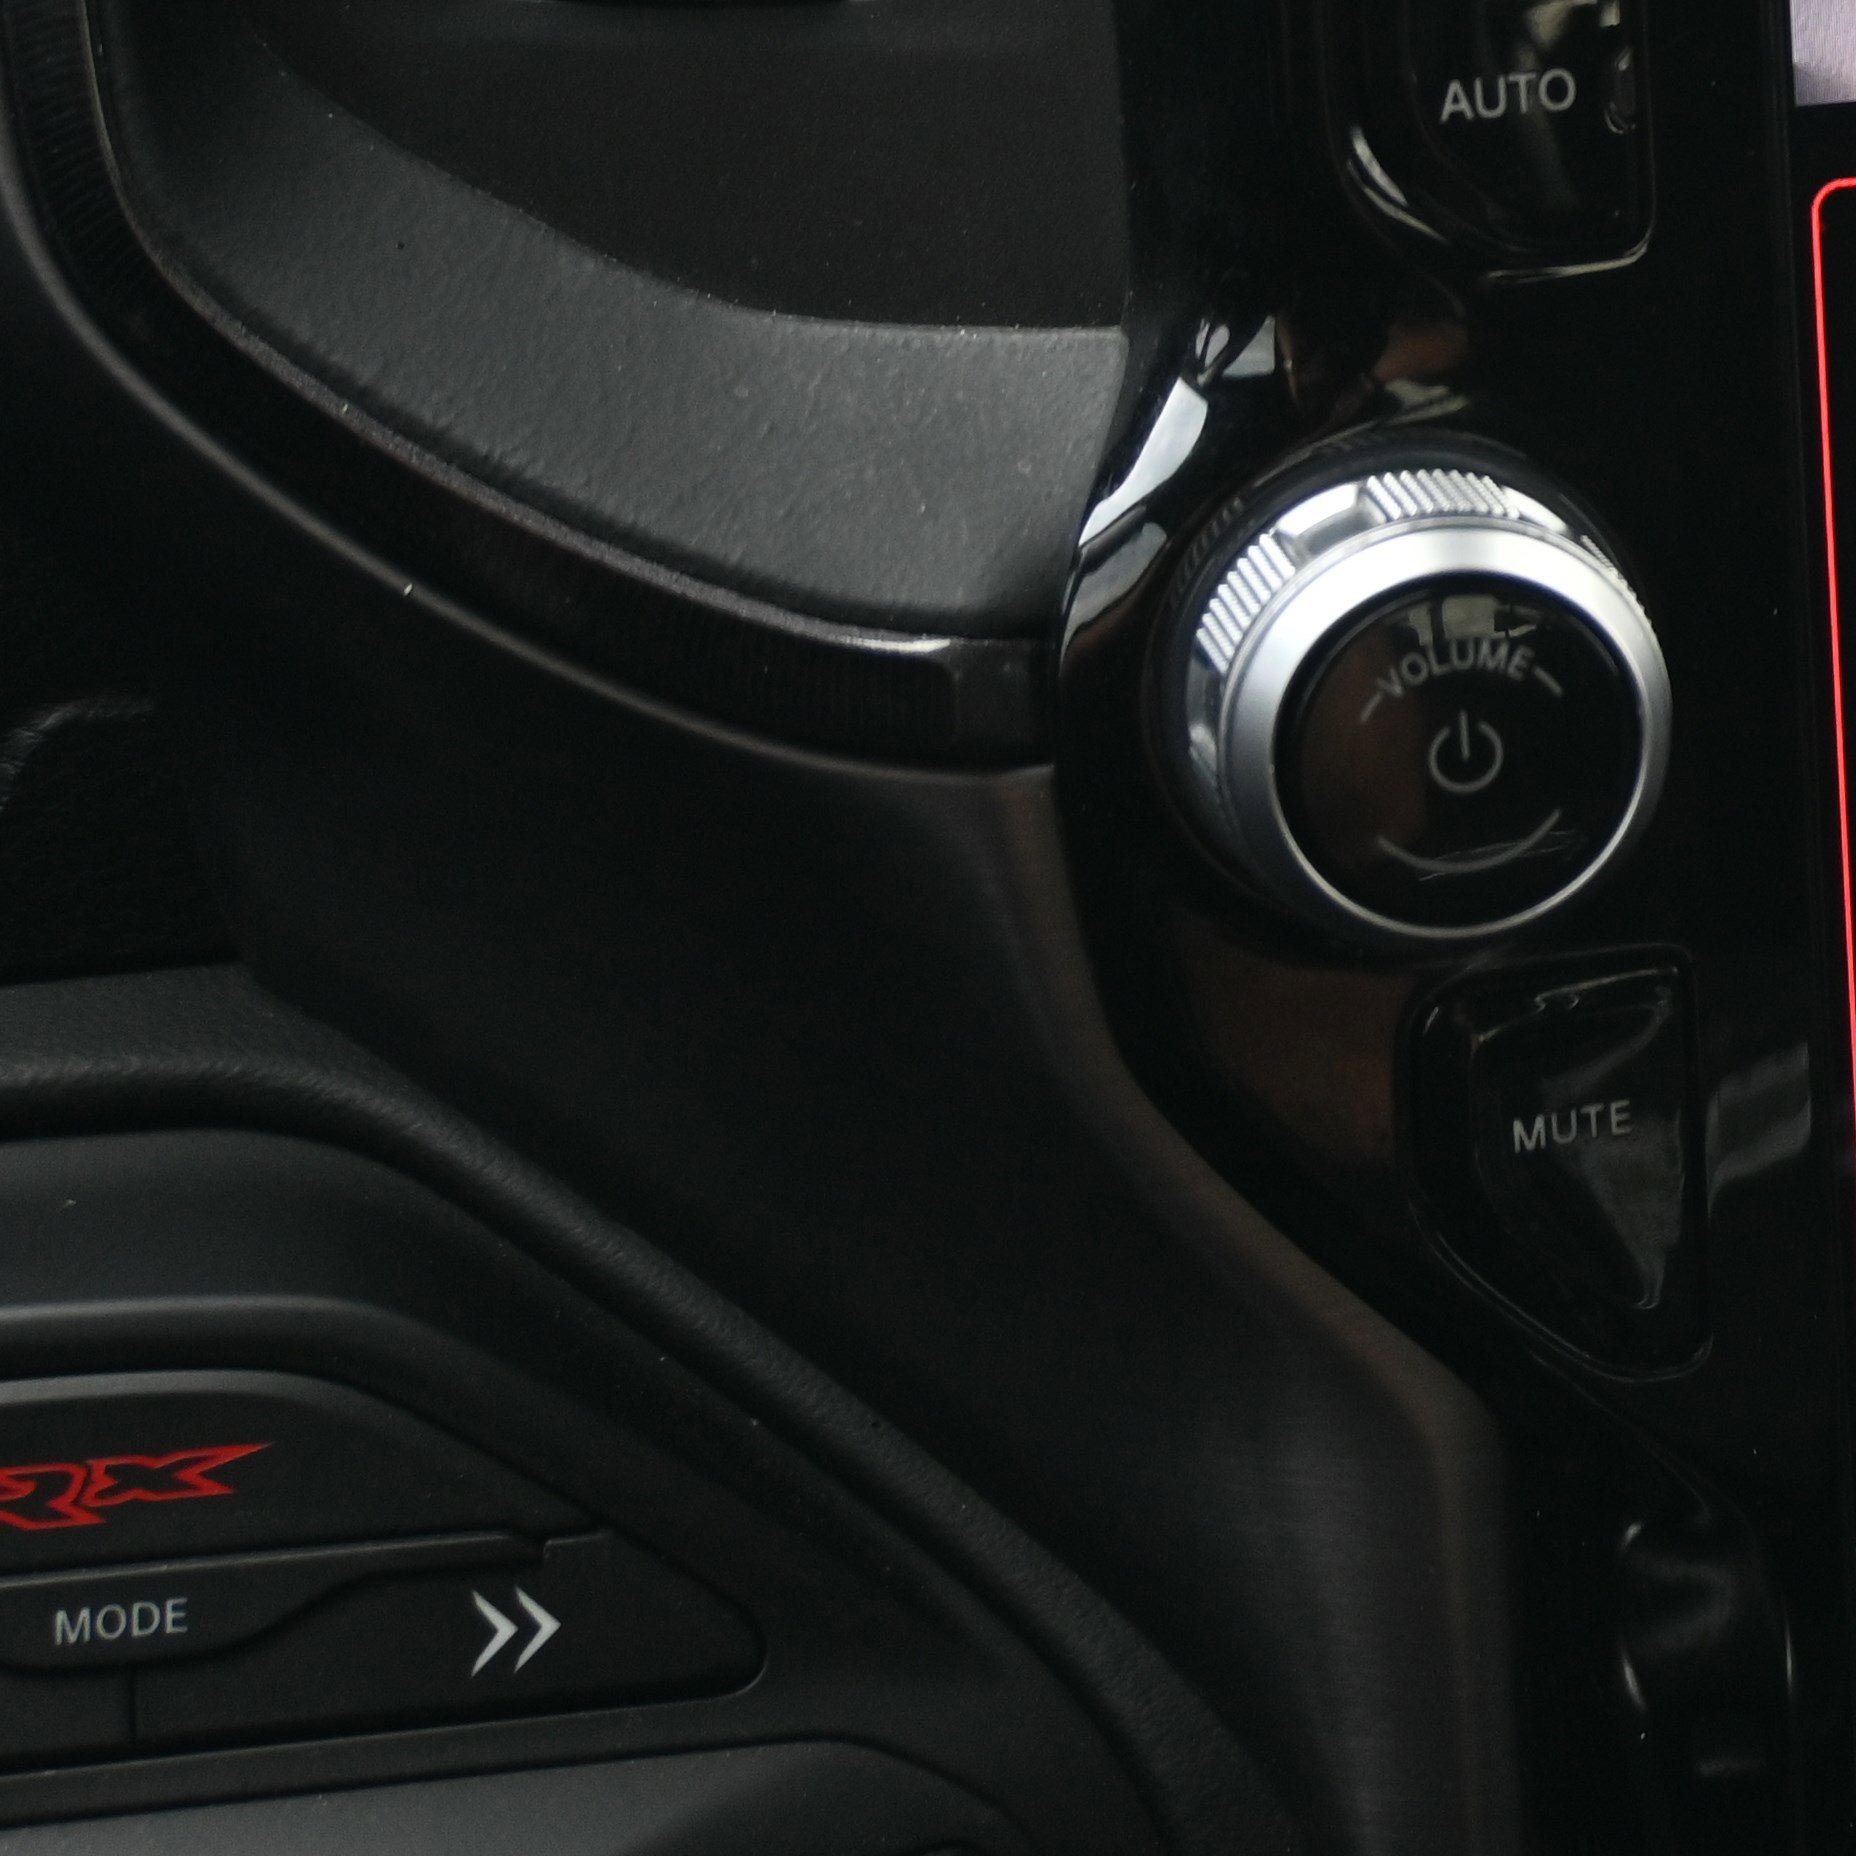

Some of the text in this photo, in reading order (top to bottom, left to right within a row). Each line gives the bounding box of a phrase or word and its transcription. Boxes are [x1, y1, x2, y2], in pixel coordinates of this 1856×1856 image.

[1440, 66, 1577, 123] AUTO
[1375, 637, 1536, 697] VOLUME
[1512, 1100, 1631, 1153] MUTE
[54, 1597, 188, 1646] MODE
